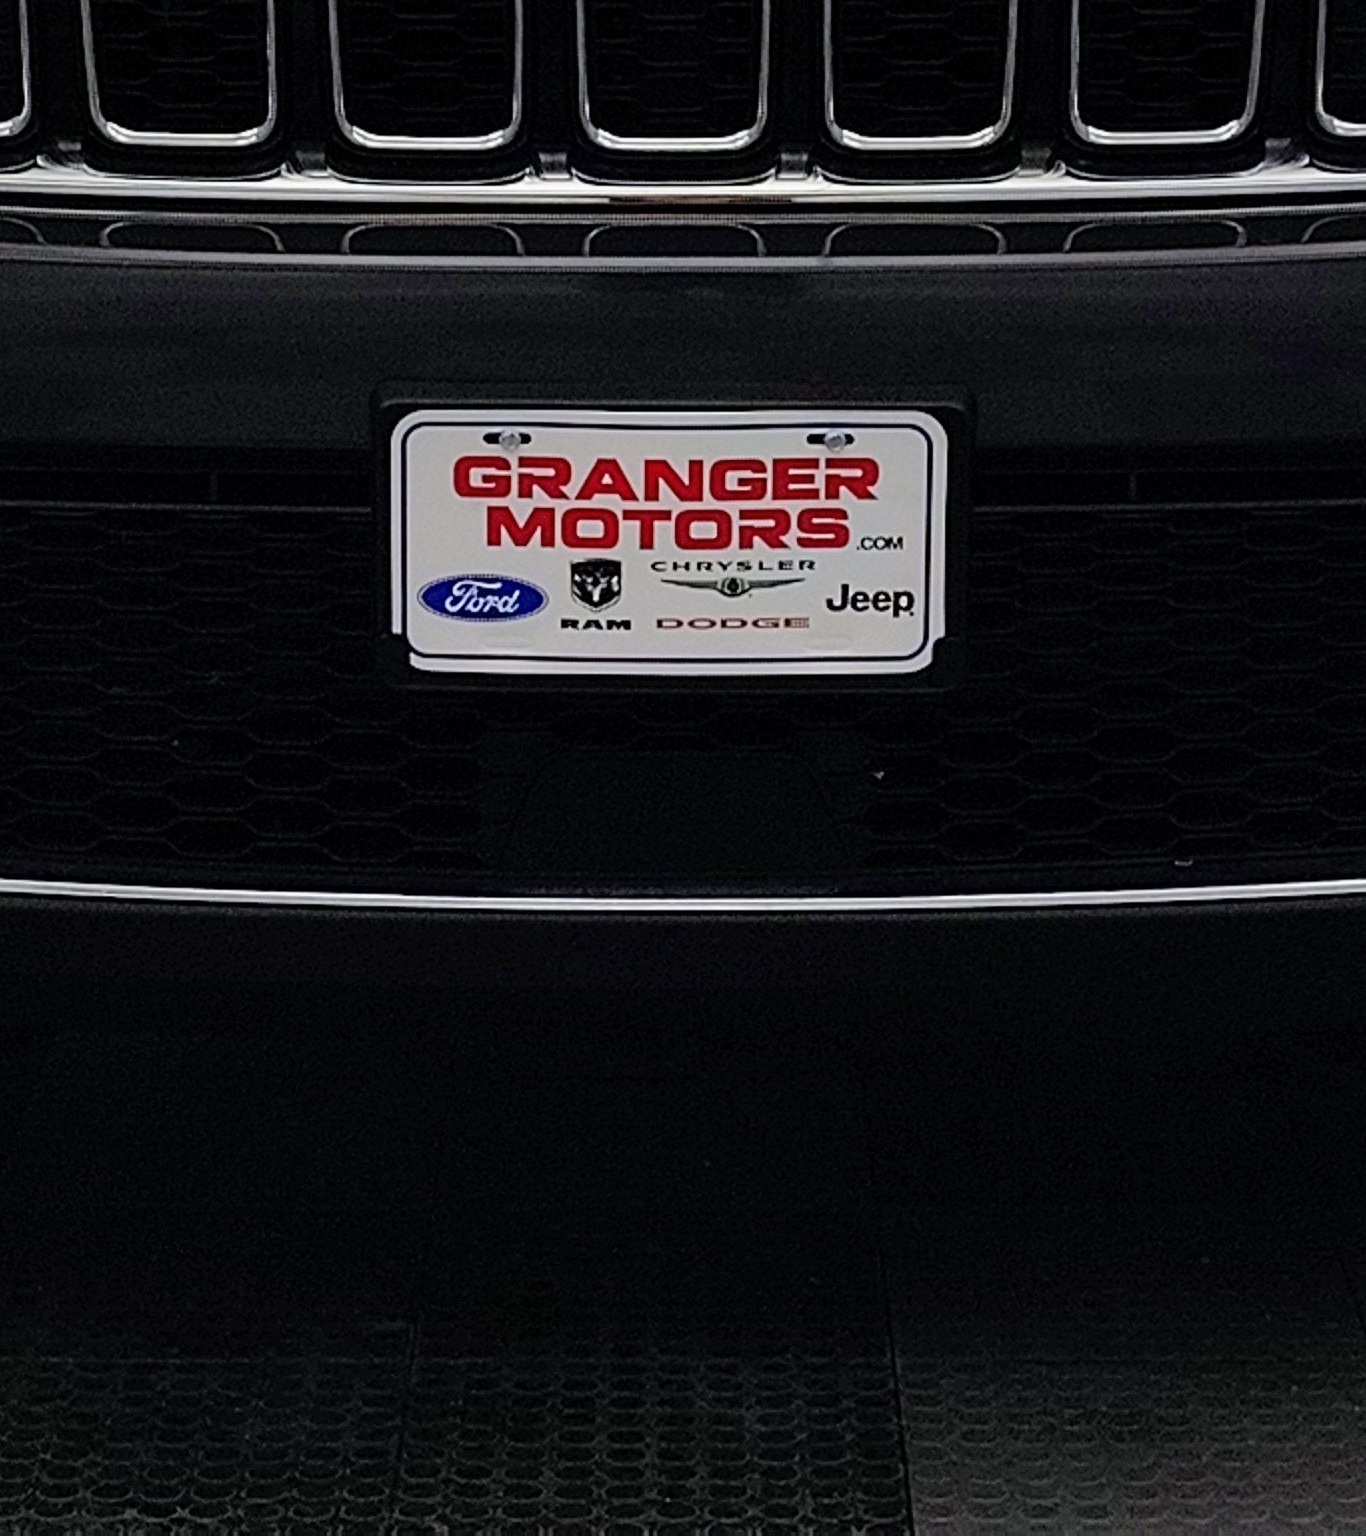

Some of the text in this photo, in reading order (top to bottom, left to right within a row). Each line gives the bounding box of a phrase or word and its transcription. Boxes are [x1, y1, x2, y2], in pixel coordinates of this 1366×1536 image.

[452, 455, 880, 501] GRANGER
[485, 506, 851, 550] MOTORS
[650, 559, 816, 572] CHRYSLER
[444, 579, 520, 613] Ford
[825, 583, 915, 617] Jeep
[560, 618, 632, 630] RAM
[655, 617, 810, 629] DODGE
